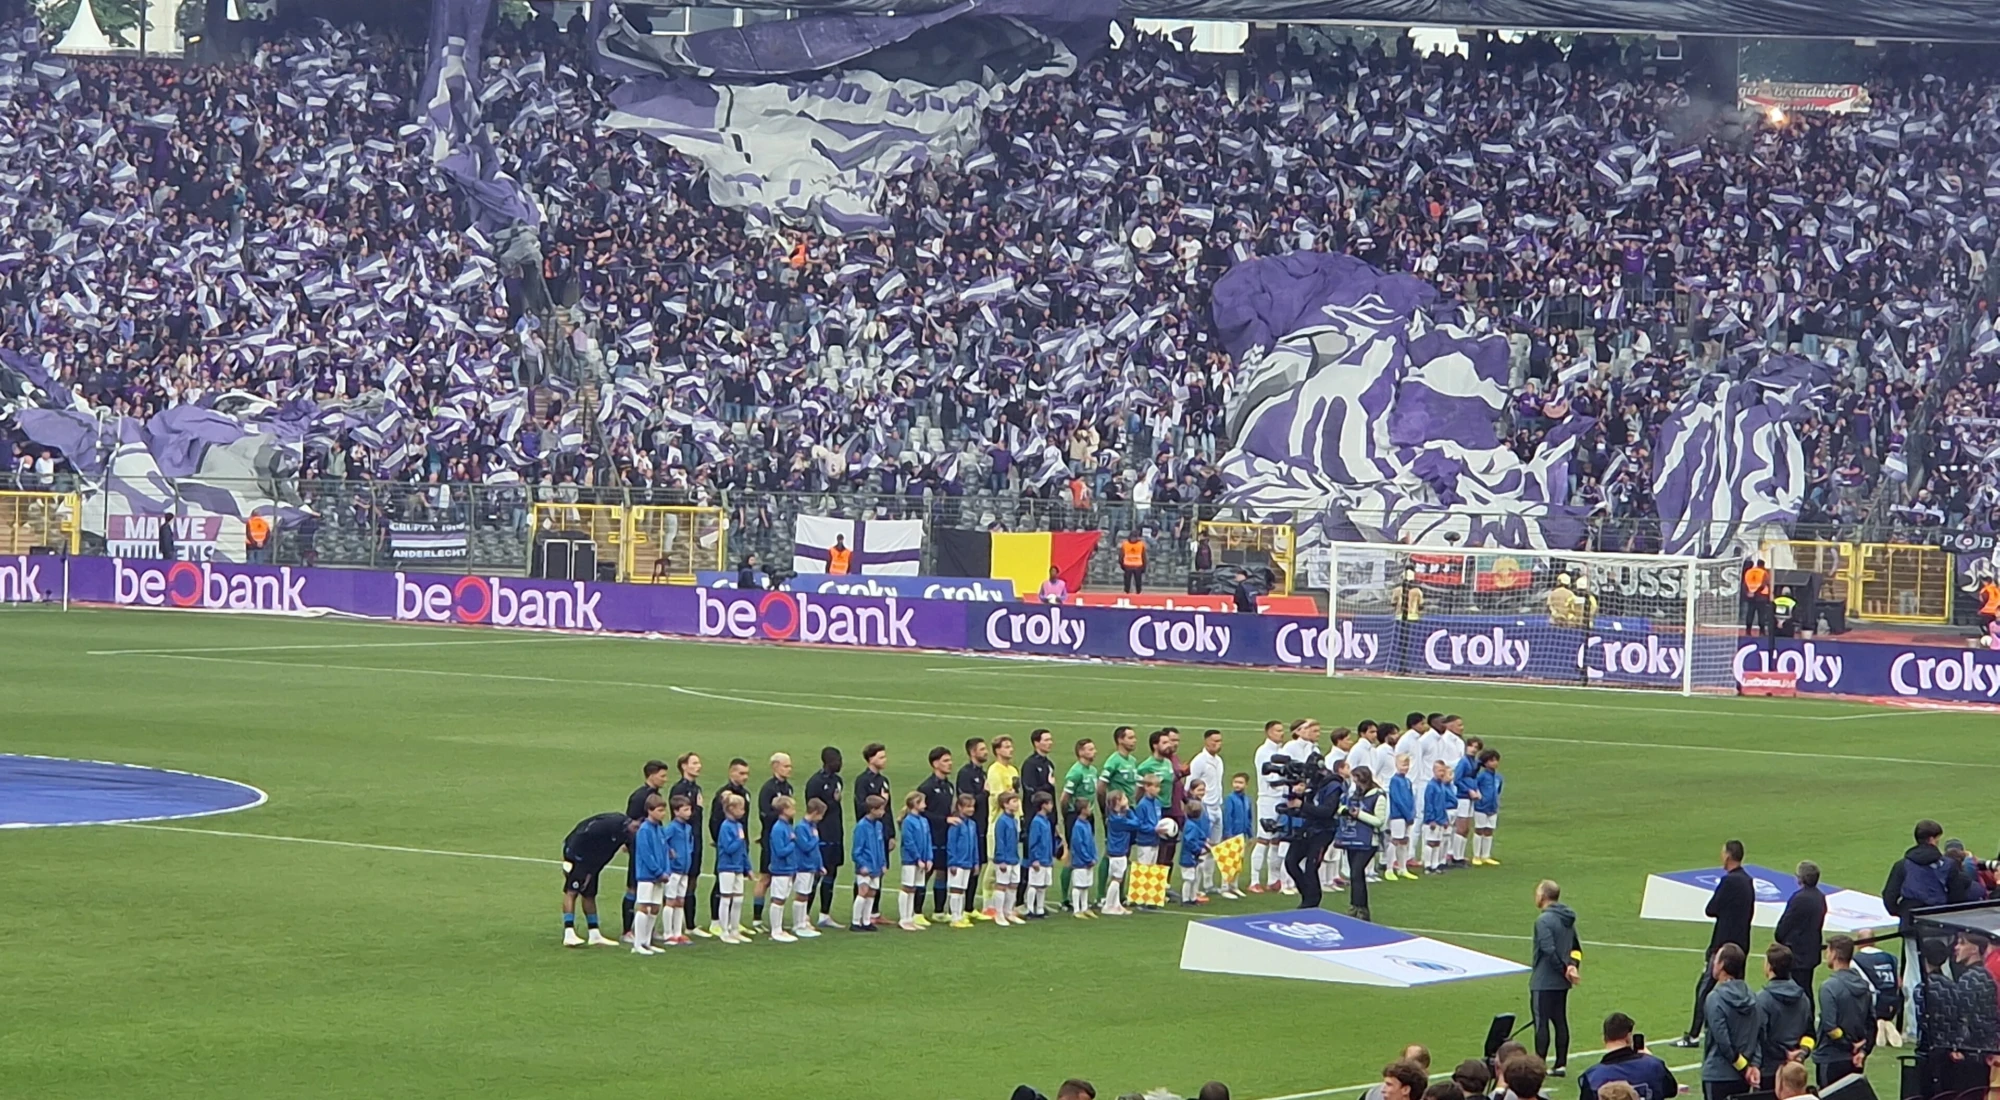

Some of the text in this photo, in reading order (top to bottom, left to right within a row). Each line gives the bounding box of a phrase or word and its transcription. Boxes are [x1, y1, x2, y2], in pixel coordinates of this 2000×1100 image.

[124, 515, 207, 540] MAVE
[392, 548, 468, 559] ANDERLECHT
[986, 606, 1086, 651] Croky
[1129, 613, 1231, 658] Croky
[1275, 620, 1379, 665] Croky
[1424, 627, 1530, 672] Croky
[1577, 634, 1685, 680] Croky
[1732, 641, 1843, 689] Croky
[1890, 651, 2000, 698] Croky
